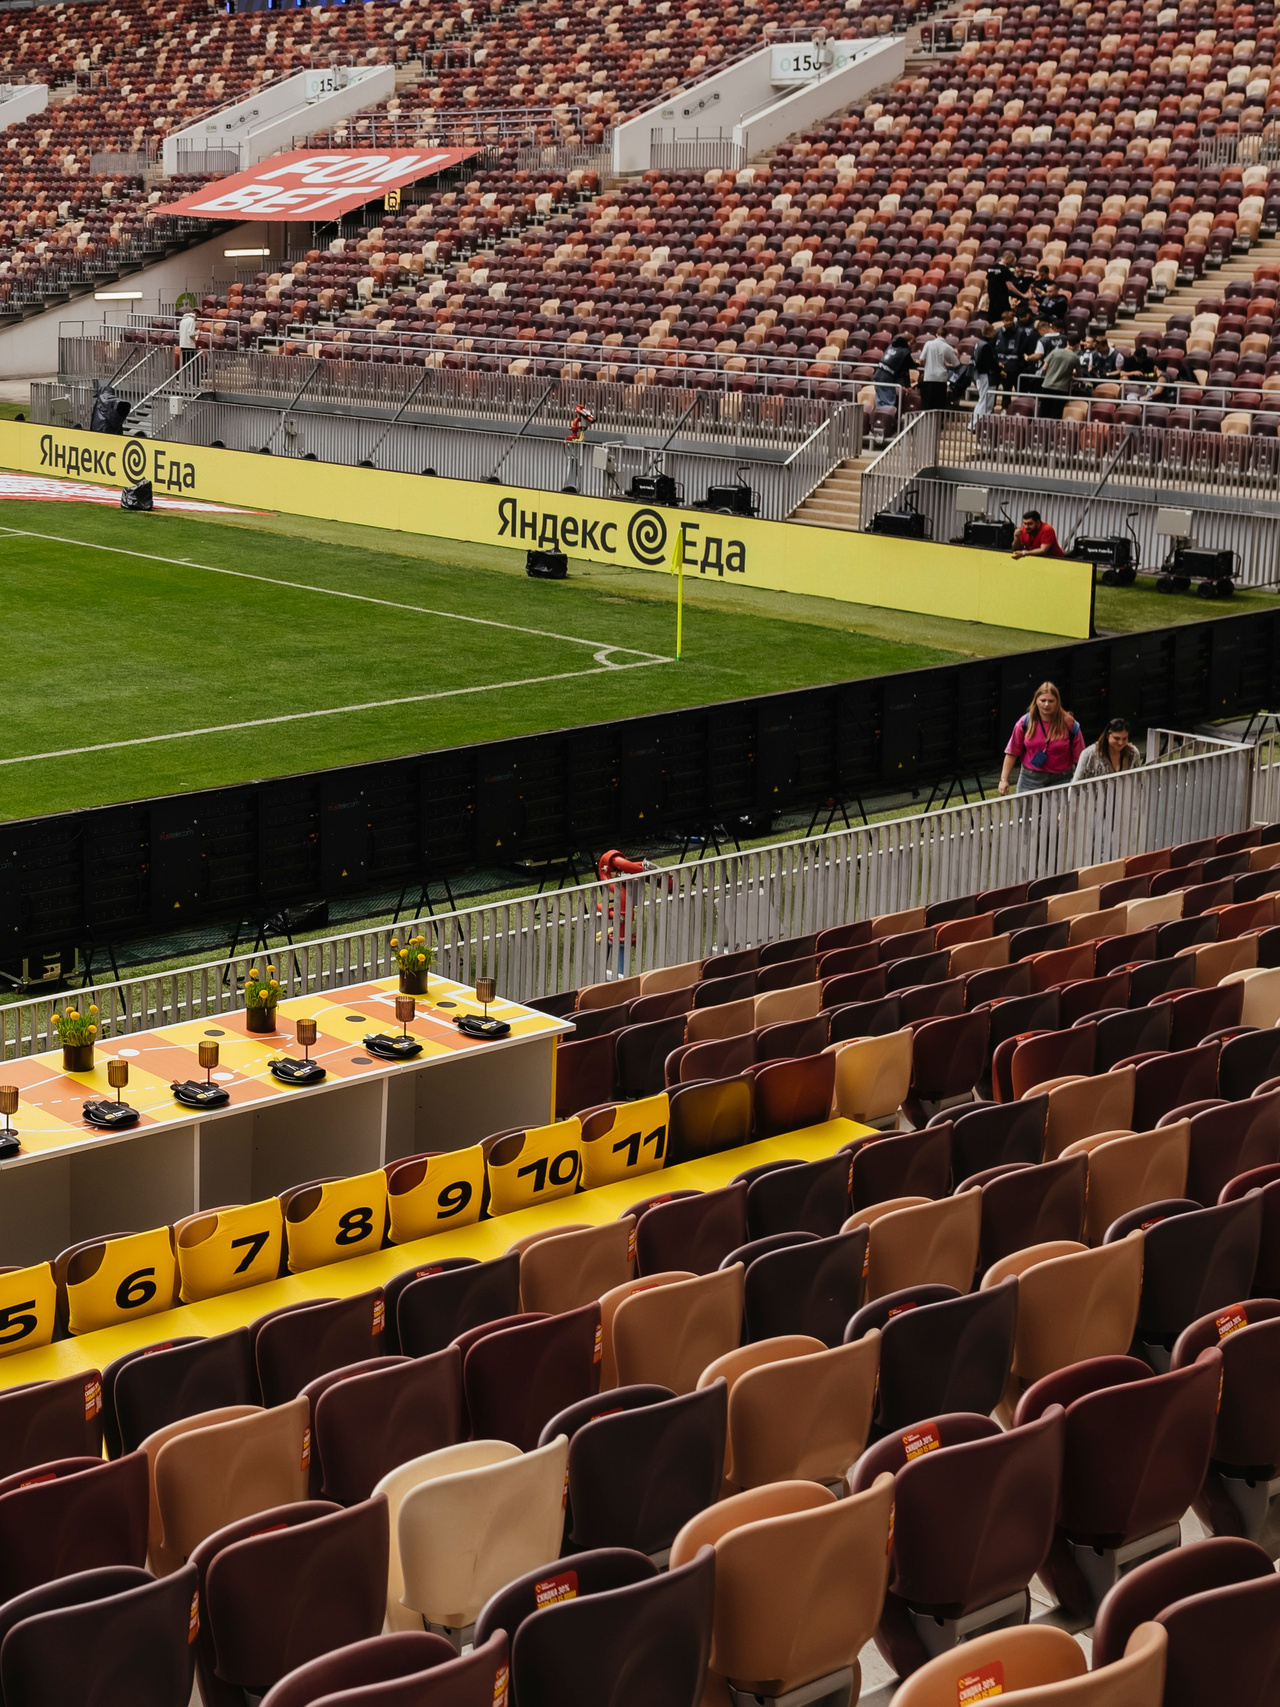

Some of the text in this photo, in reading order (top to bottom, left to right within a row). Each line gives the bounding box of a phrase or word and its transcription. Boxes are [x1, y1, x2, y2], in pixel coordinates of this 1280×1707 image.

[254, 154, 451, 184] FON
[187, 184, 383, 214] BET
[40, 434, 196, 492] Яндекс Еда
[497, 497, 746, 577] Яндекс Еда
[612, 1125, 667, 1168] 11
[517, 1149, 580, 1193] 10
[436, 1180, 473, 1220] 9
[335, 1206, 374, 1246] 8
[231, 1230, 271, 1274] 7
[114, 1267, 157, 1310] 6
